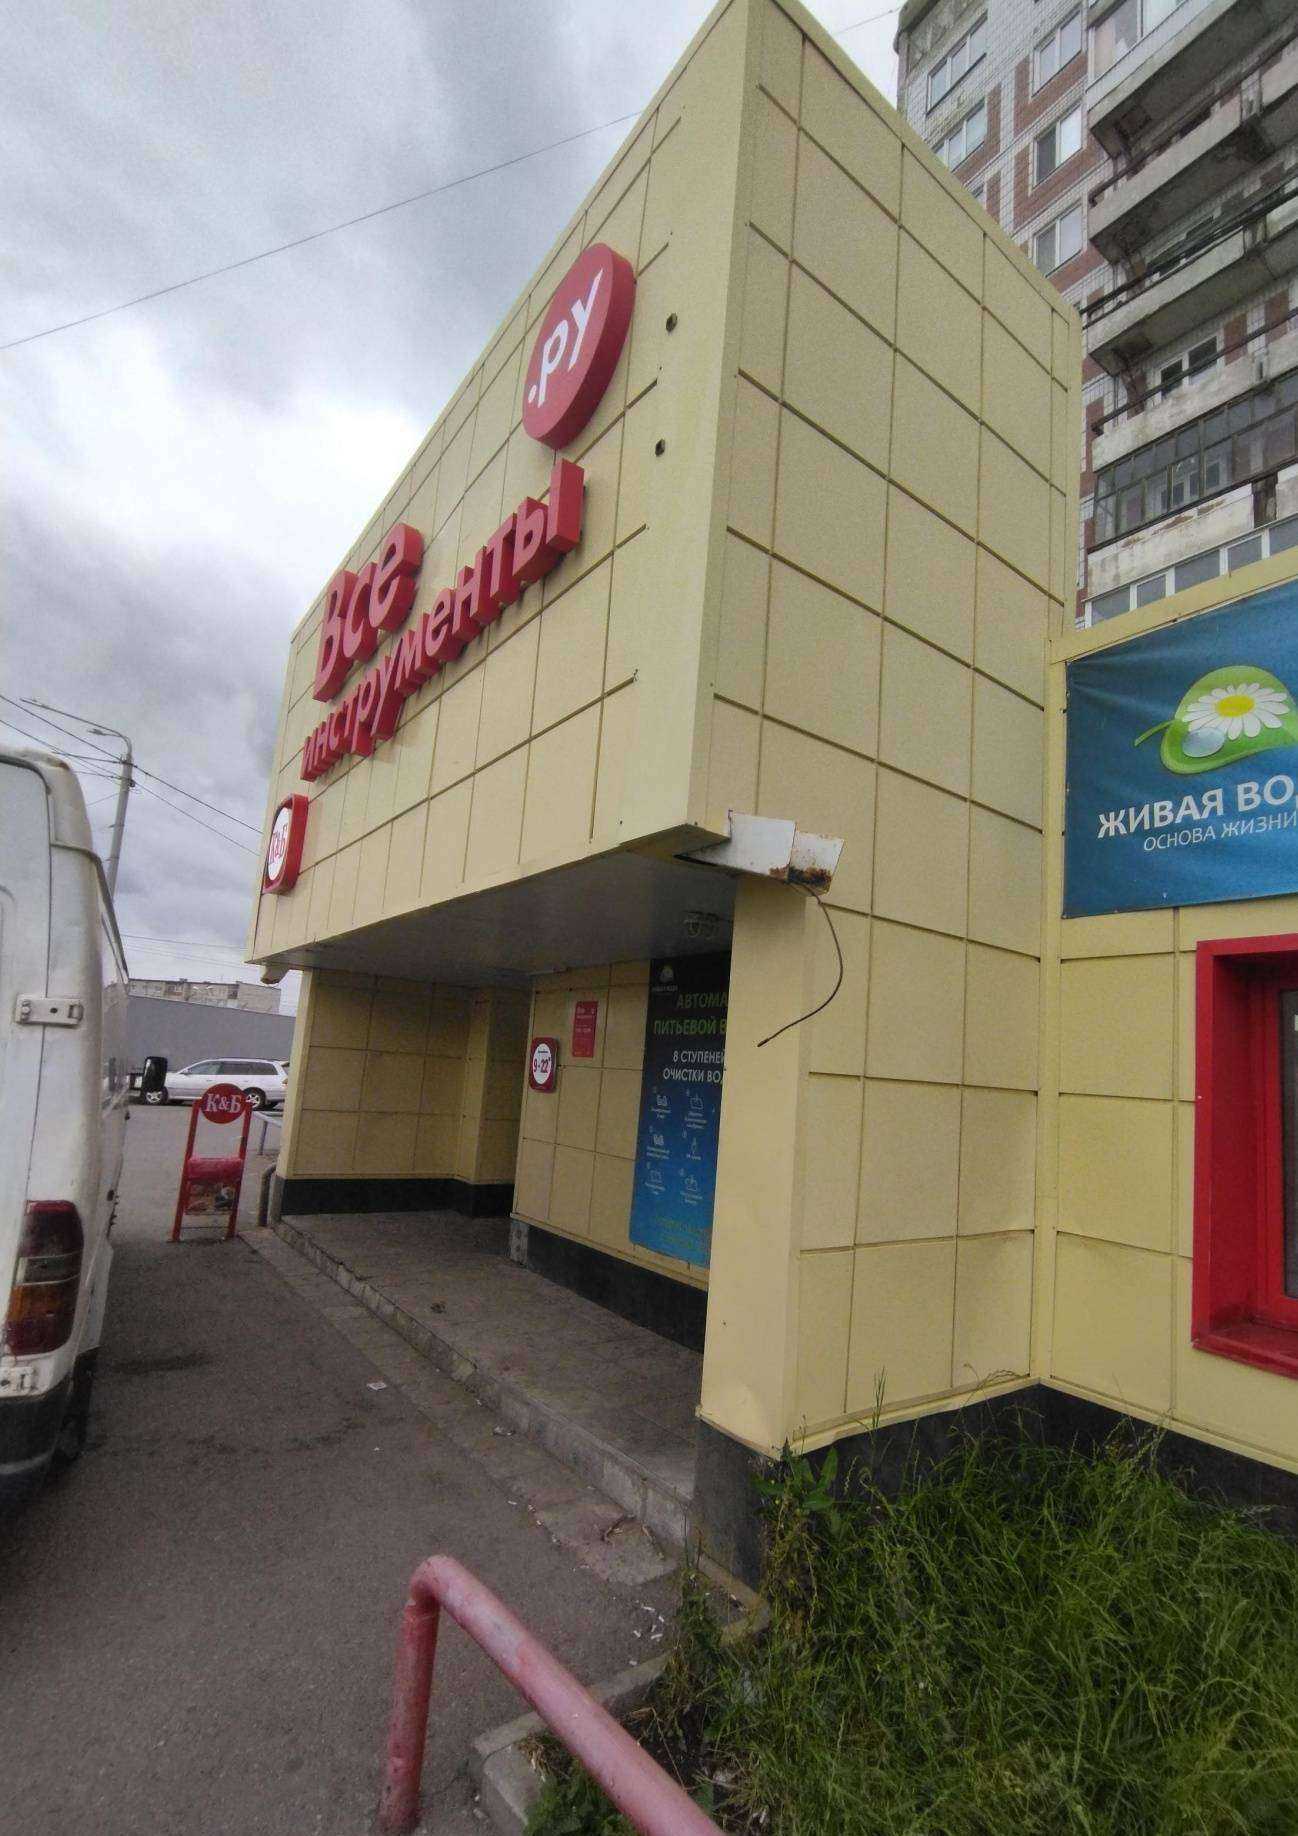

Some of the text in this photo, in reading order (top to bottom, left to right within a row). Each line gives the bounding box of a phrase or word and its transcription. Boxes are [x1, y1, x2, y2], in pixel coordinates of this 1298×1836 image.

[300, 458, 584, 782] инструменты
[312, 522, 424, 703] Все
[1097, 774, 1298, 839] ЖИВАЯ ВО
[1143, 810, 1297, 851] ОСНОВА ЖИЗНИ
[654, 1016, 717, 1036] ПИТЬЕВОЙ
[673, 1050, 679, 1063] 8
[662, 1067, 723, 1084] ОЧИСТКИ ВО
[205, 1093, 241, 1114] К&Б
